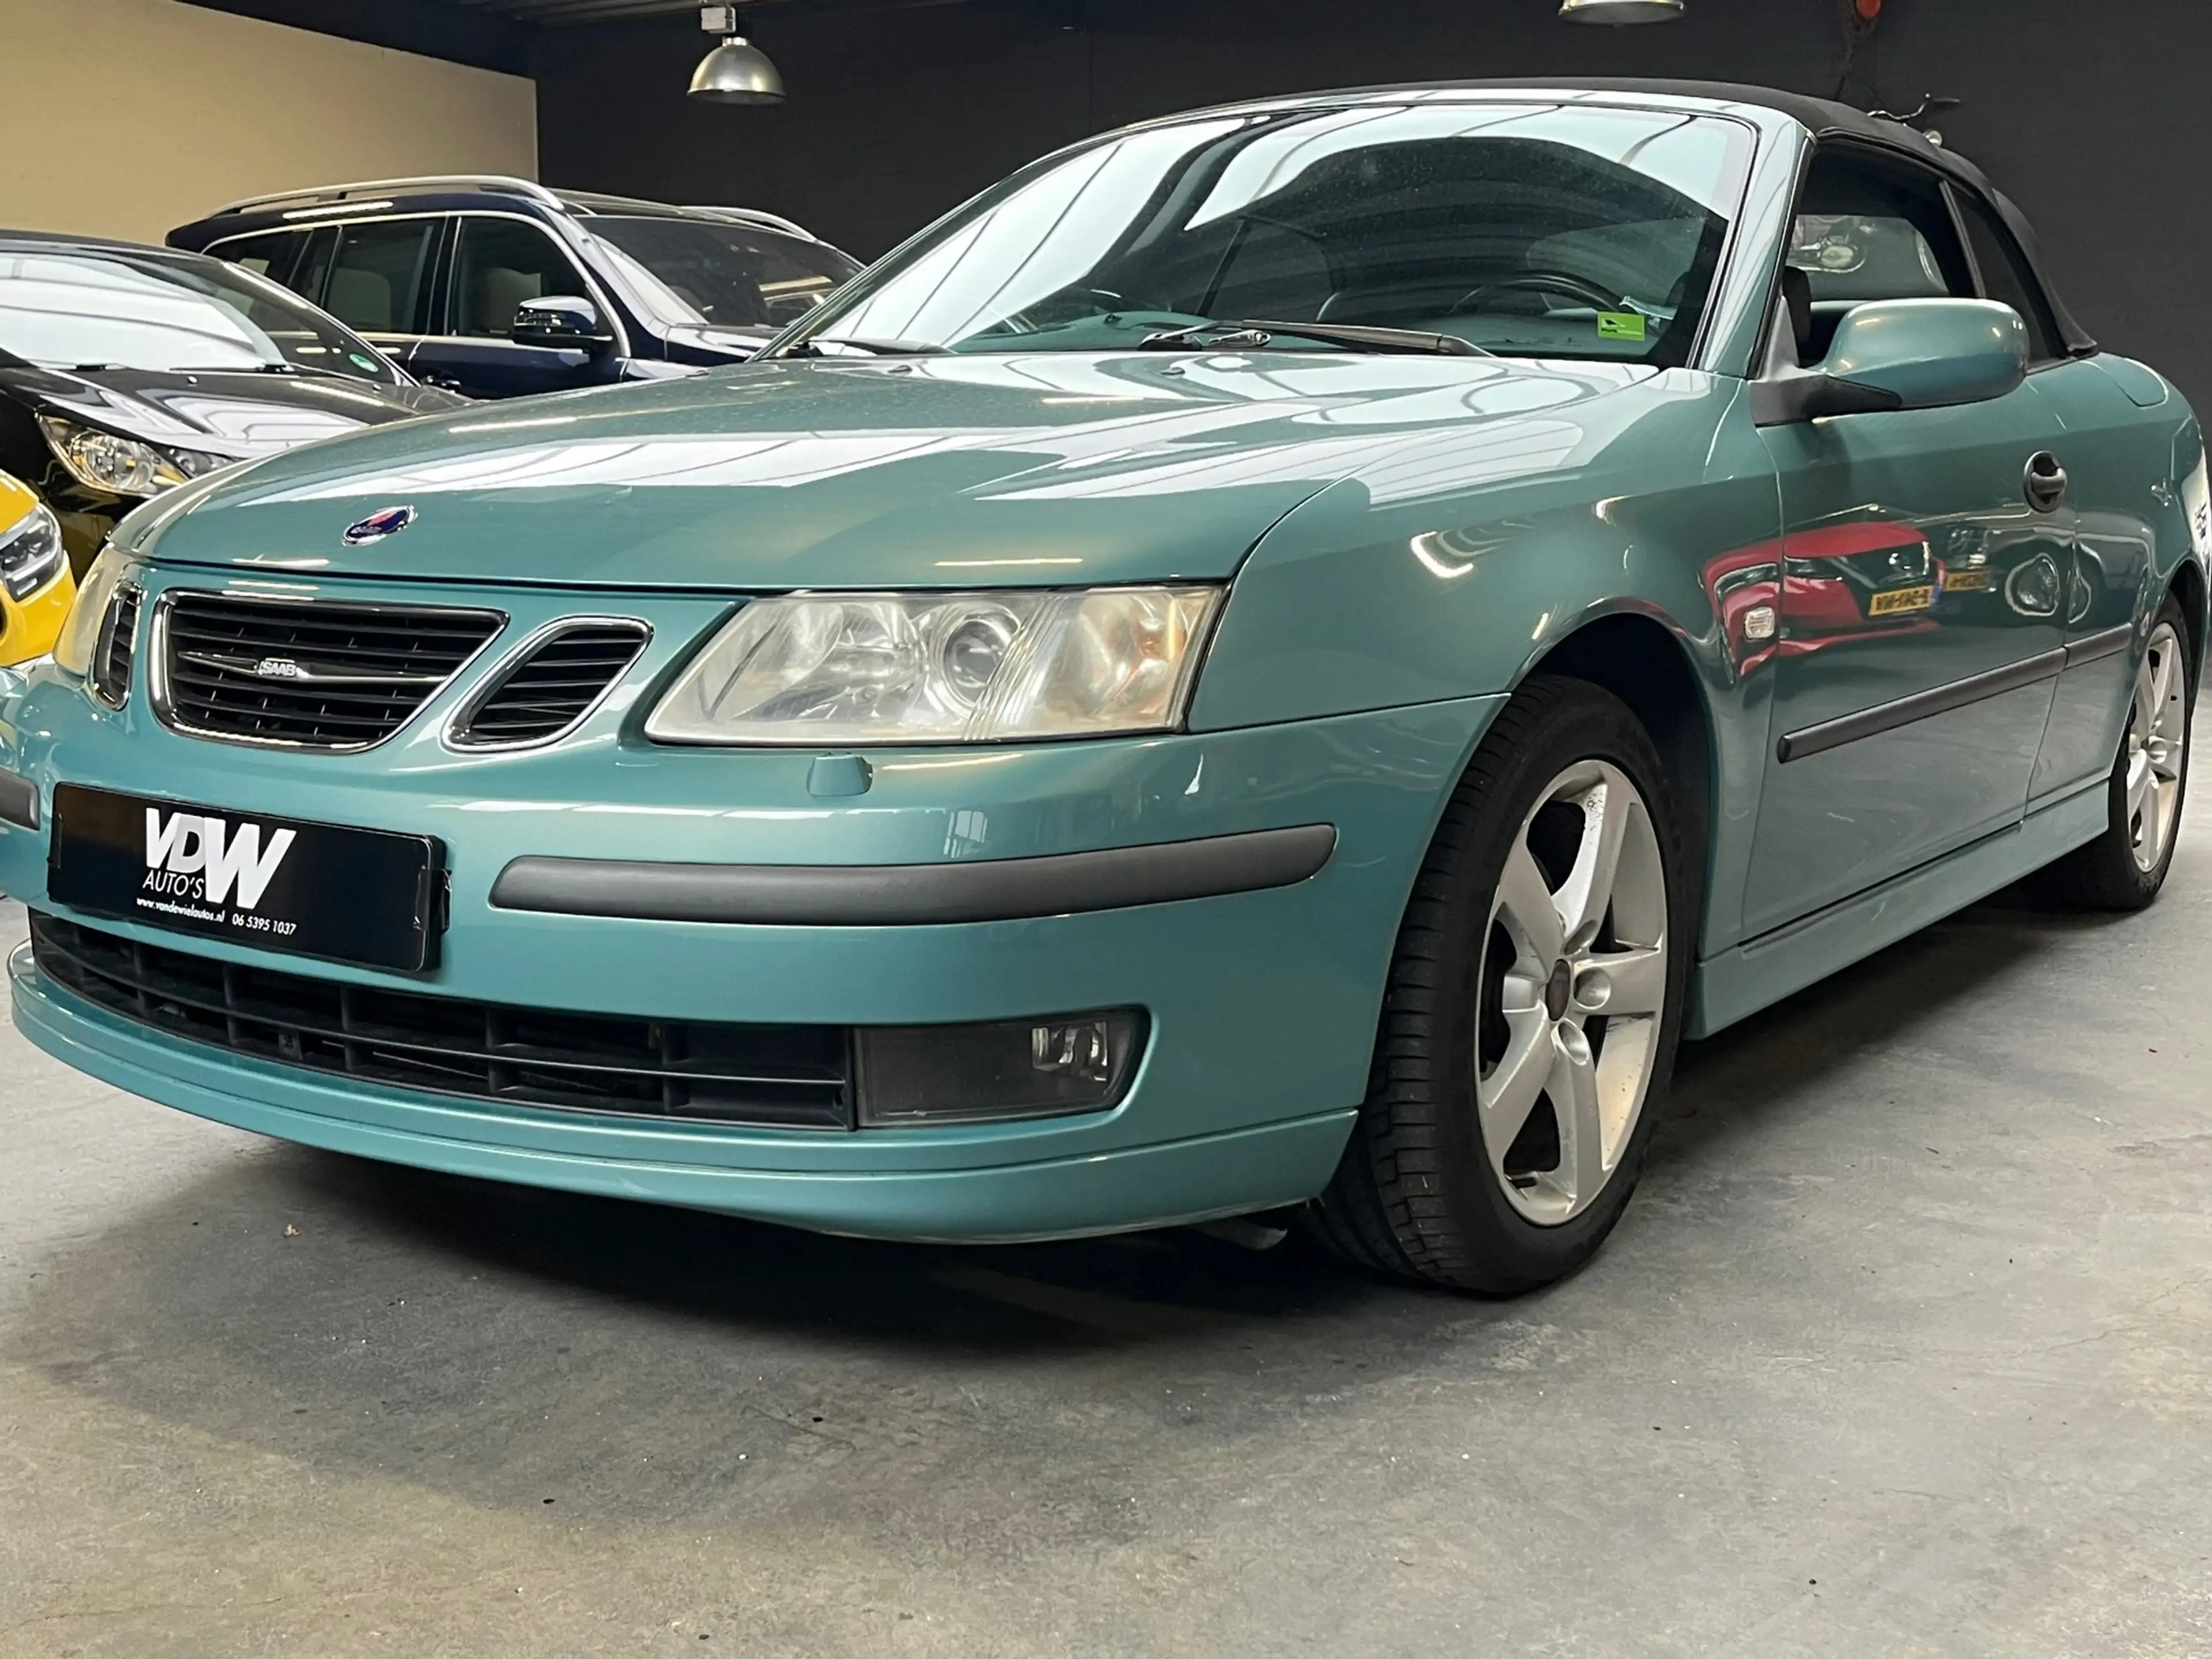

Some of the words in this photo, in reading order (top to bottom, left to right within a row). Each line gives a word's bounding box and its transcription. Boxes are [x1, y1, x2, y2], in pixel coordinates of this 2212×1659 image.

[262, 661, 296, 676] SAAB
[146, 807, 297, 910] VDW
[142, 869, 204, 899] AUTO'S
[137, 897, 225, 922] www.vandewielautos.nl
[232, 913, 244, 926] 06
[246, 914, 270, 932] 5395
[272, 921, 297, 935] 1037
